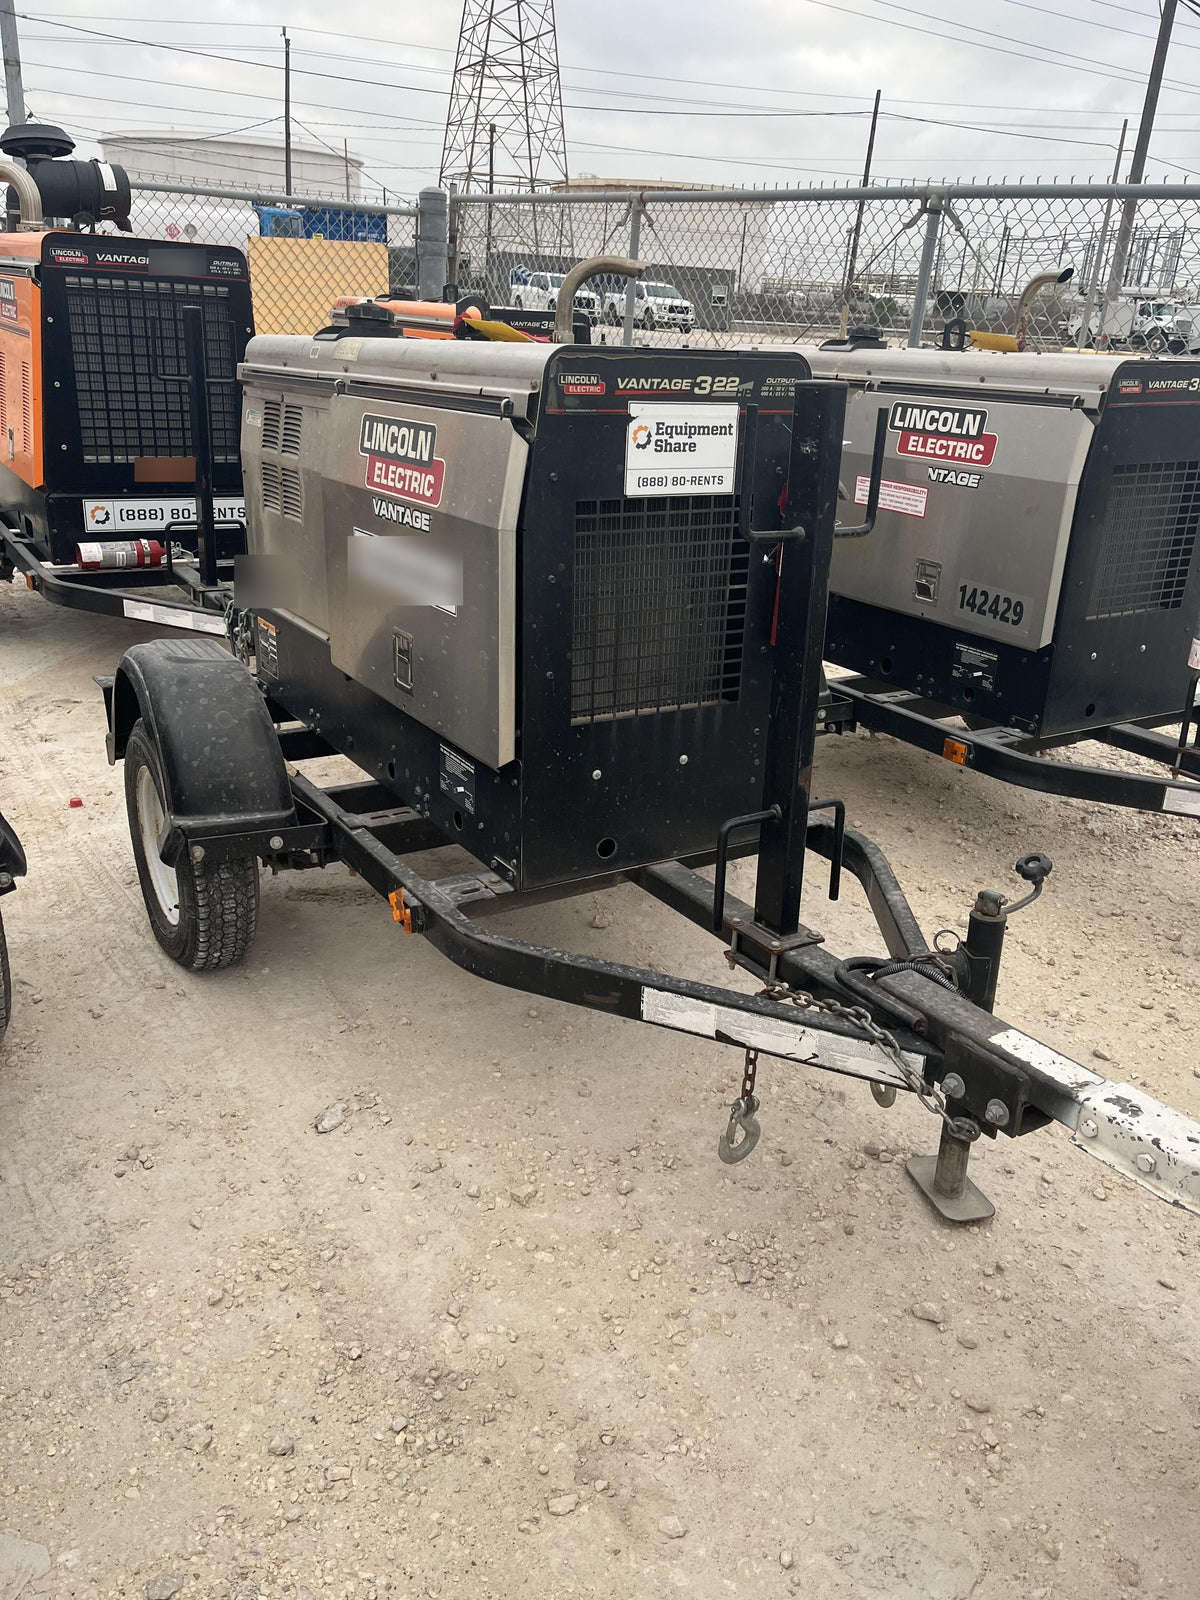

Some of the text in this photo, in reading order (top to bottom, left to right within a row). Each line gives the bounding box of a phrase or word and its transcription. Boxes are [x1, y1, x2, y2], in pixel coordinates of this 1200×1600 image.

[51, 249, 81, 257] LINCOLN
[96, 253, 149, 264] VANTAG
[541, 321, 556, 329] 32
[560, 375, 598, 385] LINCOLN
[616, 377, 692, 390] VANTAGE
[693, 375, 740, 395] 322
[766, 377, 796, 385] OUTPUT
[1148, 377, 1200, 391] VANTAGE 3
[569, 385, 601, 393] ELECTRIC
[893, 406, 982, 436] LINCOLN
[655, 422, 734, 439] Equipment
[363, 420, 432, 462] LINCOLN
[654, 439, 697, 453] Share
[907, 435, 985, 461] ELECTRIC
[373, 461, 435, 497] ELECTRIC
[637, 475, 724, 488] (888) 80-RENTS
[119, 507, 165, 522] (888)
[372, 497, 431, 532] VANTAGE
[959, 584, 1024, 626] 142429
